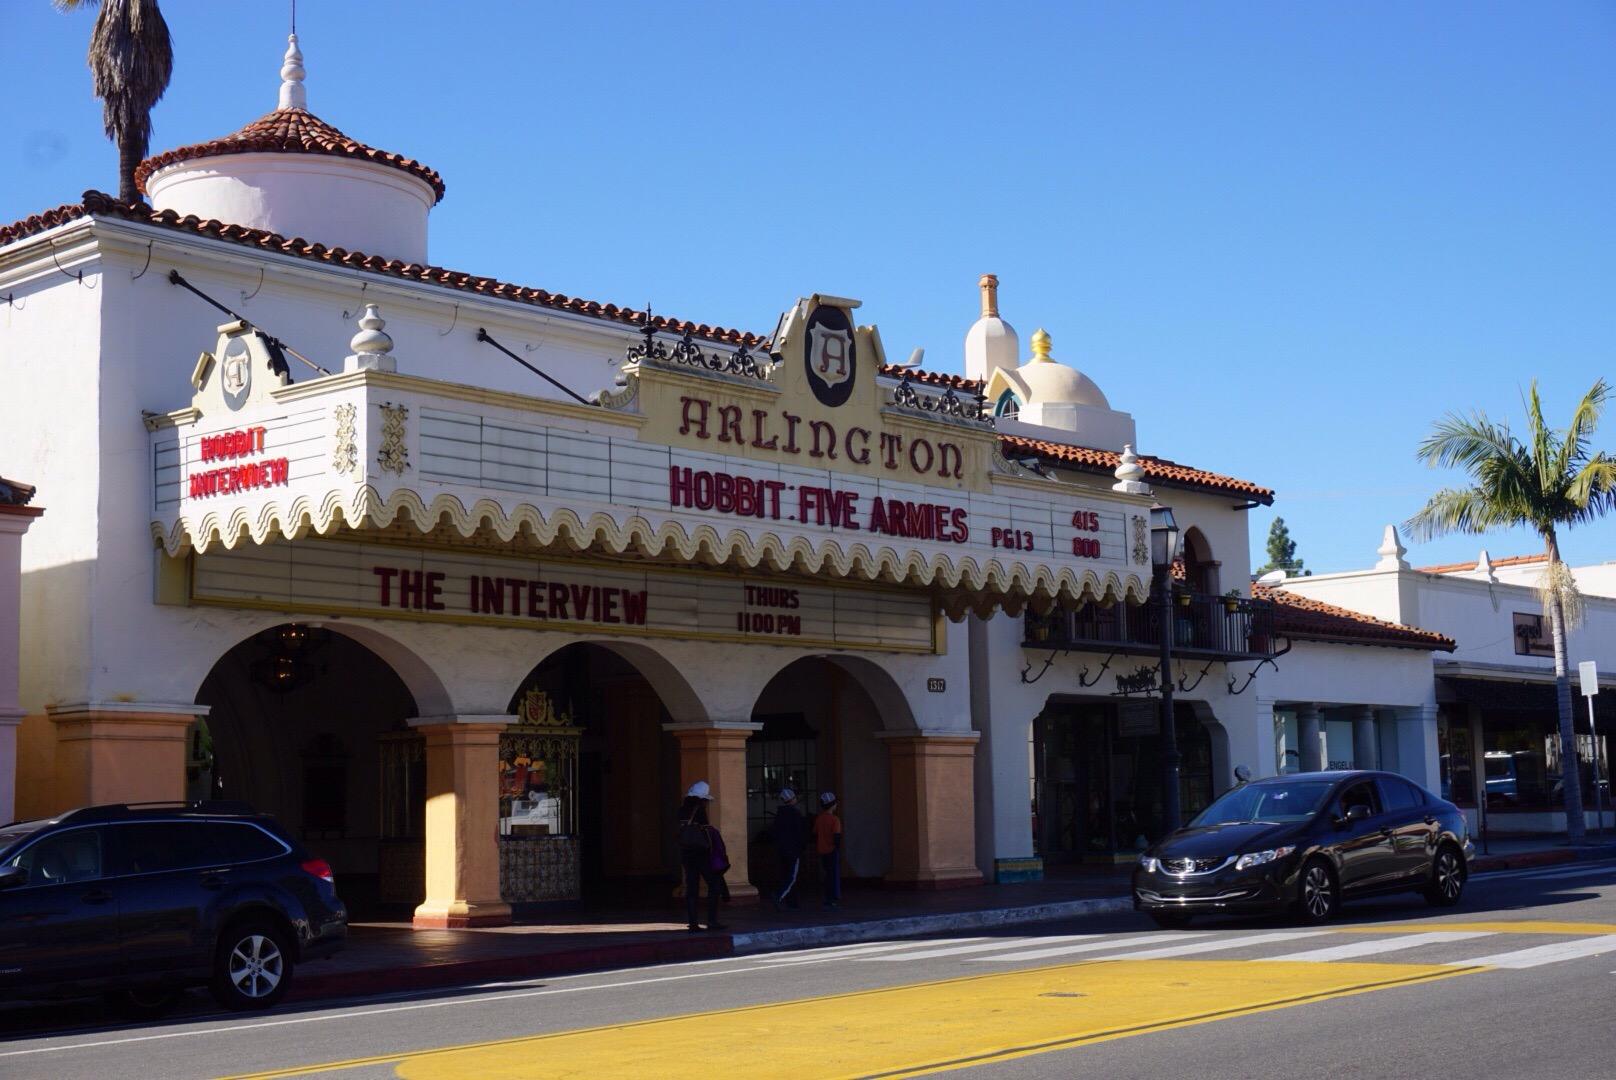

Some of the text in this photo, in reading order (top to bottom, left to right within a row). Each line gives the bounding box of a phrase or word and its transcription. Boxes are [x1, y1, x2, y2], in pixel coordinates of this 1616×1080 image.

[820, 333, 847, 376] A
[201, 427, 267, 463] HOBBIT
[679, 396, 964, 480] ARLINGTON
[189, 457, 289, 500] INTERVIEW
[799, 485, 859, 530] FIVE
[870, 496, 969, 544] ARMIES
[1072, 510, 1099, 532] 415
[992, 527, 1034, 552] PG13
[373, 566, 648, 625] THE INTERVIEW
[744, 585, 799, 609] THURS
[777, 614, 801, 635] PM
